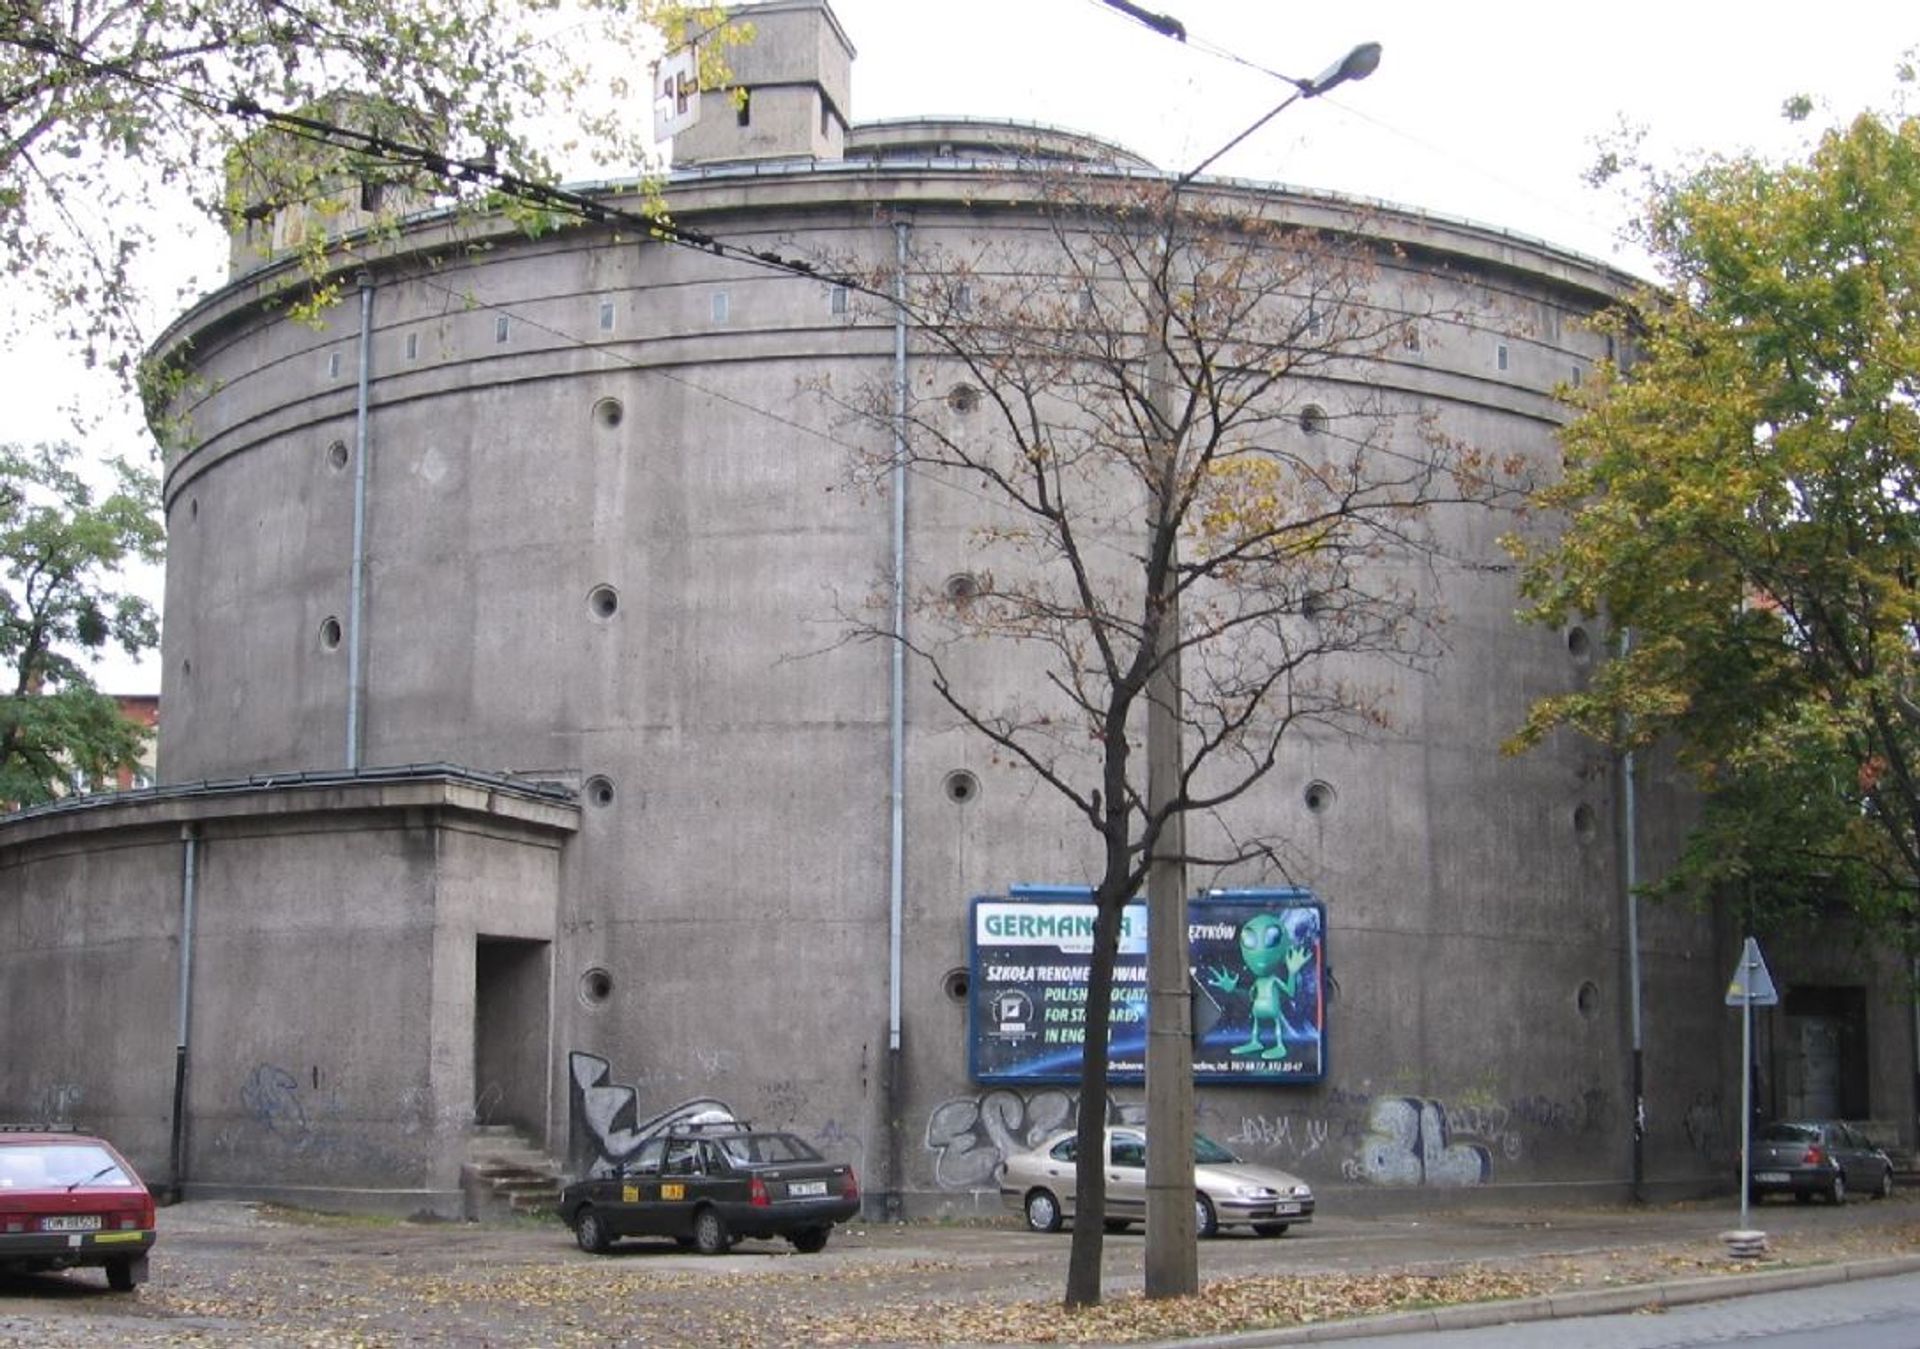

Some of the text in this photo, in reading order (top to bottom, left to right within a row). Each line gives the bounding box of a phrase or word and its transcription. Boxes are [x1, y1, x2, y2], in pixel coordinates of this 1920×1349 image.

[985, 914, 1132, 938] GERMANA
[1188, 922, 1236, 944] ĘZYKÓW
[986, 965, 1034, 983] SZKOŁA
[1044, 987, 1088, 1002] POLISH
[1044, 1008, 1140, 1022] FOR STARDS
[1044, 1028, 1057, 1043] IN
